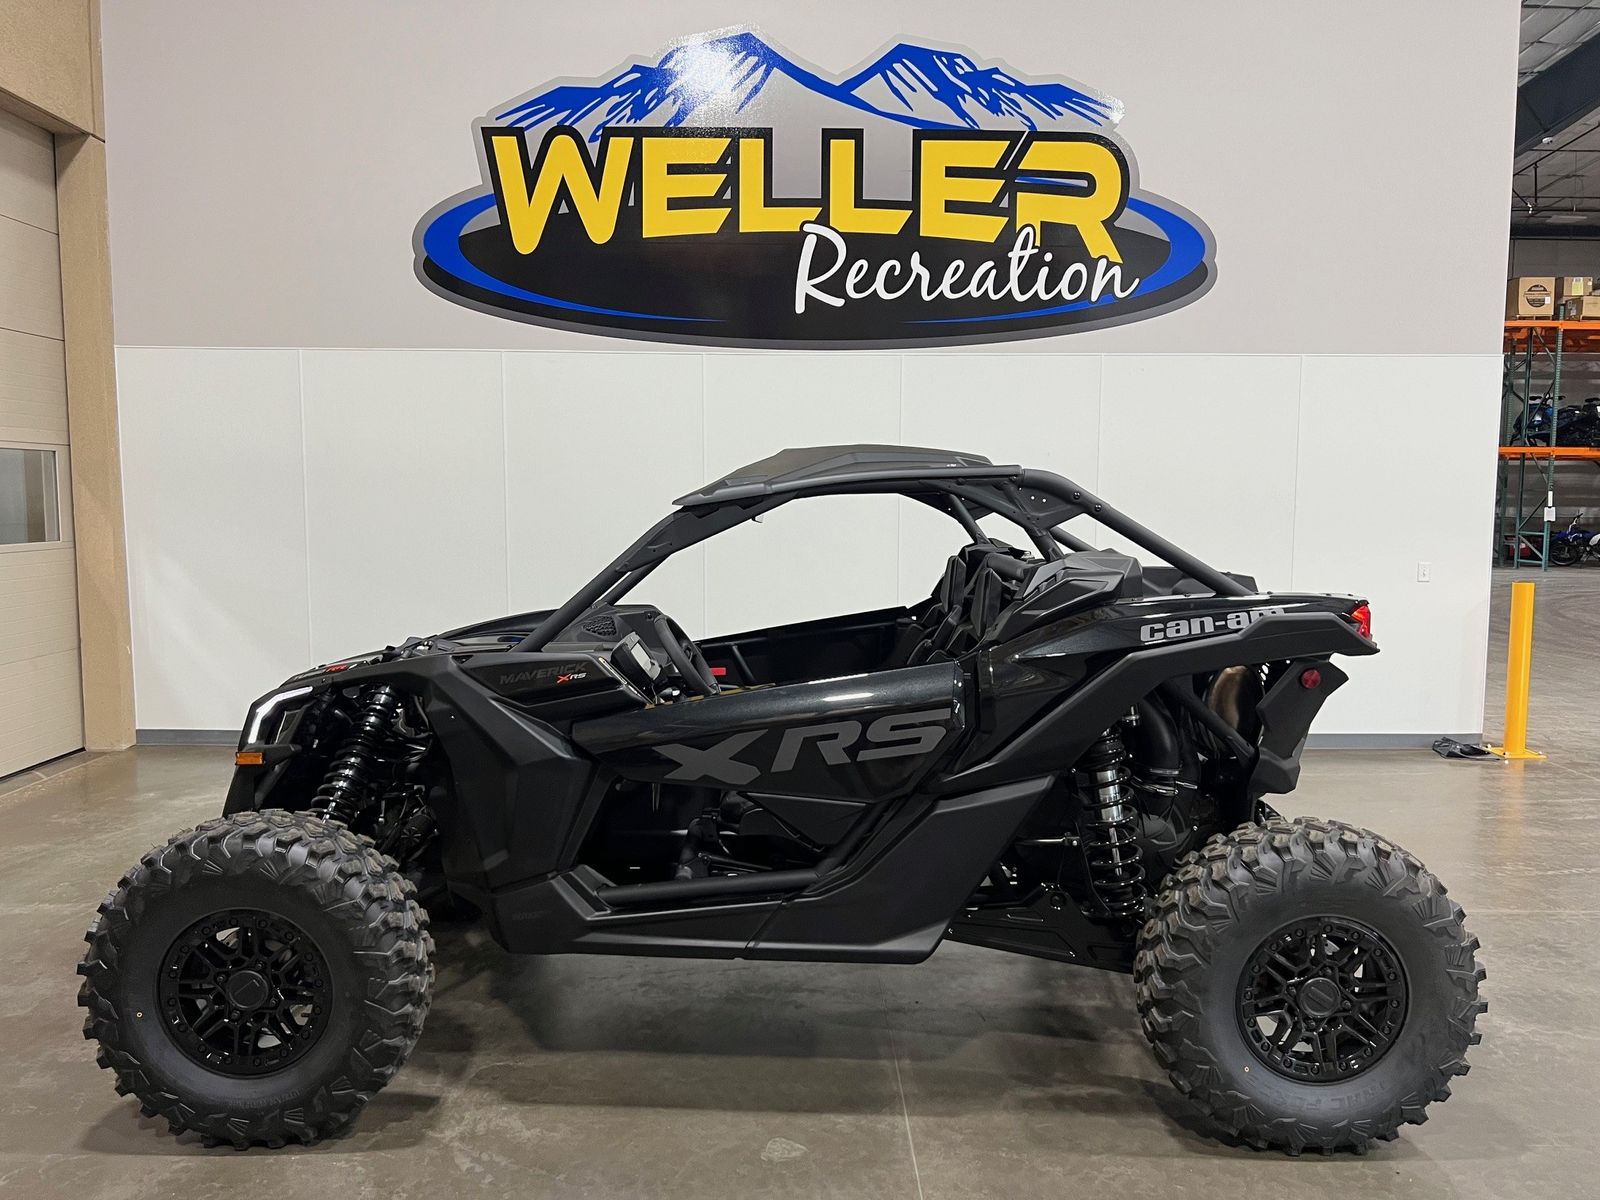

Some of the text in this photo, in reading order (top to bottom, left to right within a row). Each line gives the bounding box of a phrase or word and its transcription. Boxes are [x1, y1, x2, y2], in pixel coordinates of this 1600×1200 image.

[490, 133, 1123, 262] WELLER
[794, 222, 1140, 315] Recreation
[499, 661, 589, 685] MAVERICK
